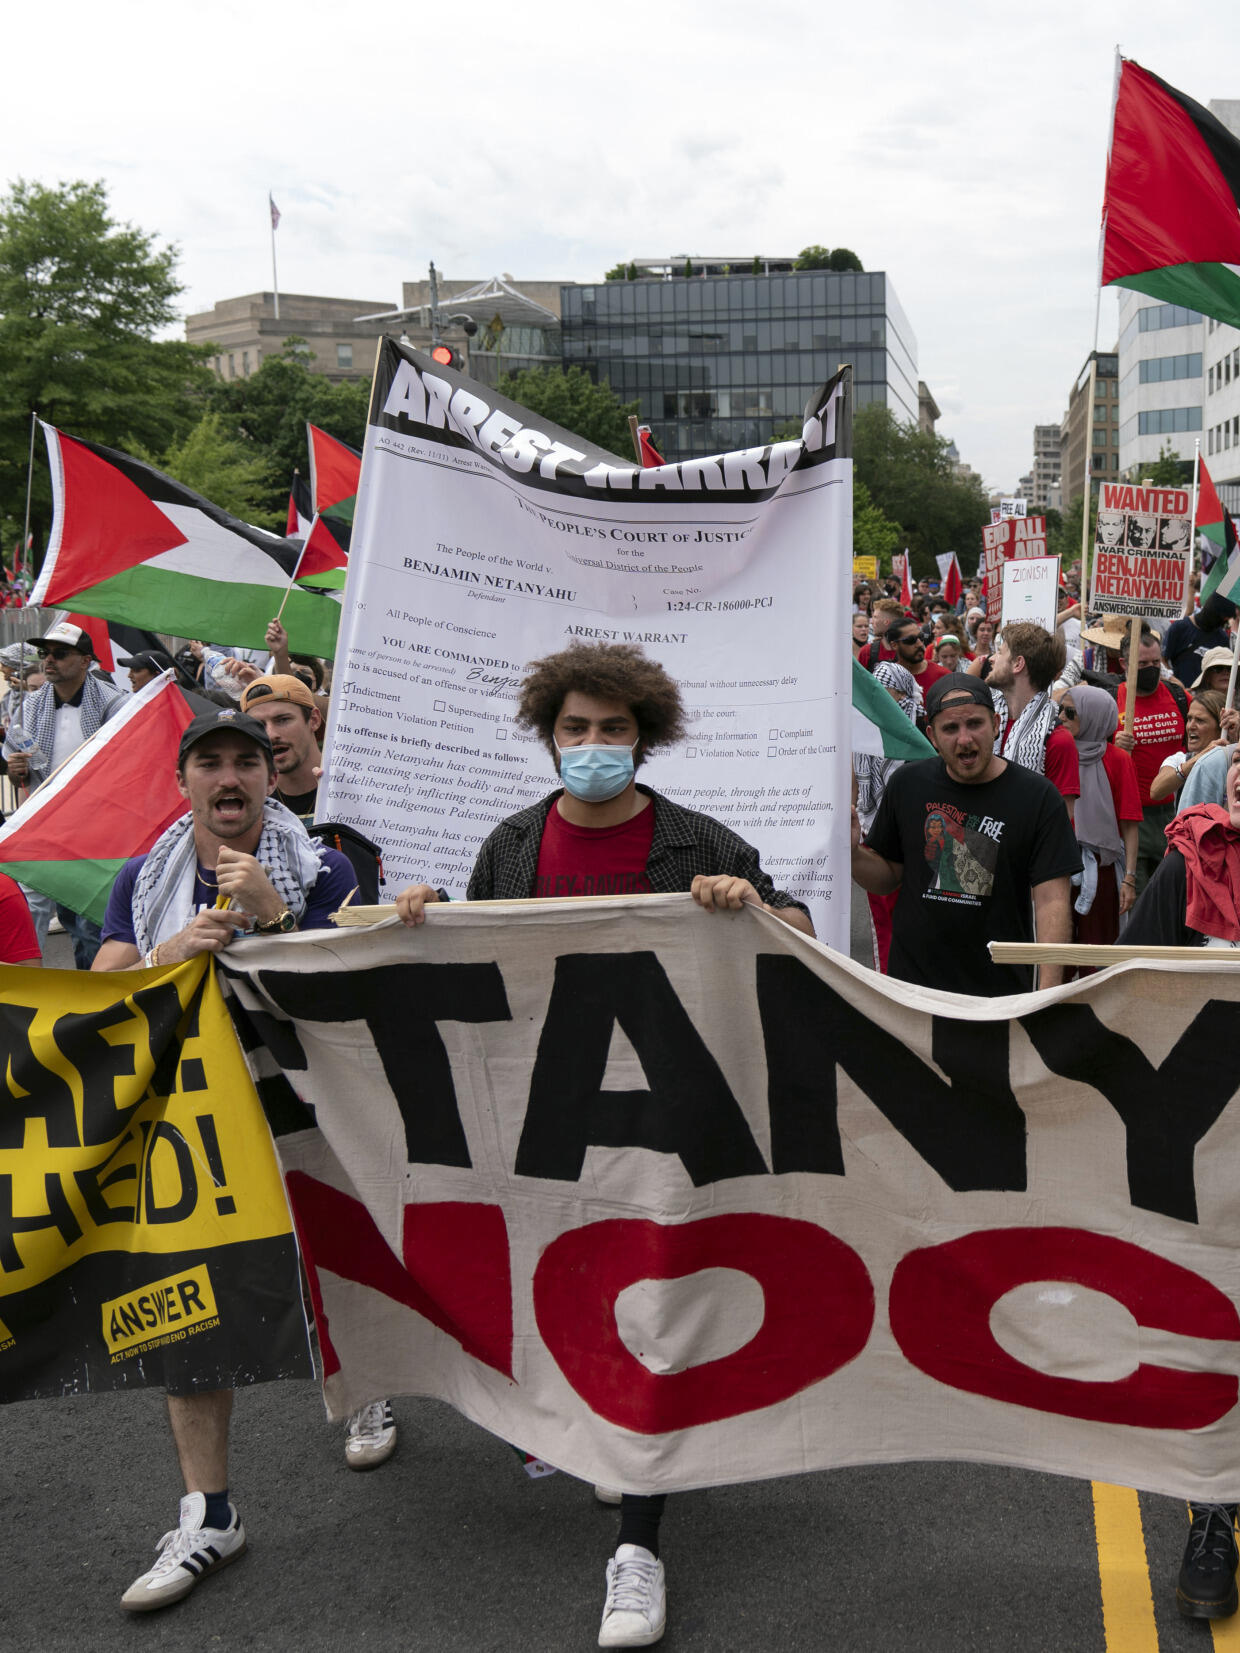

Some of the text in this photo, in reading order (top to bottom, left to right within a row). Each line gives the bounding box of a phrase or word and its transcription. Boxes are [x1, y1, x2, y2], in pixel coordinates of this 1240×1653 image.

[383, 358, 587, 480] ARREST
[452, 456, 472, 468] Arrest
[1104, 485, 1188, 515] WANTED
[1002, 503, 1013, 515] FREE
[1015, 503, 1024, 516] ALL
[610, 528, 668, 543] COURT
[672, 533, 690, 543] OF
[983, 517, 1046, 549] END ALL
[436, 543, 543, 572] The People of the World
[617, 548, 644, 557] for the
[1014, 540, 1045, 559] AID
[1098, 546, 1186, 560] WAR CRIMINAL
[606, 560, 639, 572] District
[1012, 566, 1048, 583] ZIONISM
[1097, 553, 1185, 581] BENJAMIN
[403, 557, 577, 602] BENJAMIN NETANYAHU
[1095, 574, 1184, 601] NETANYAHU
[467, 589, 506, 604] Defendant
[663, 587, 702, 595] Case No.
[666, 596, 773, 612] 1:24-CR-186000-PCJ
[1093, 601, 1182, 619] ANSWERCOALITION.ORG
[386, 608, 497, 639] All People of Conscience
[564, 624, 689, 644] ARREST WARRANT
[376, 652, 402, 664] person
[382, 635, 406, 649] YOU
[408, 642, 432, 655] ARE
[434, 647, 509, 670] COMMANDED
[372, 666, 466, 693] accused offense
[709, 680, 737, 688] without
[739, 678, 779, 689] unnecessary
[781, 676, 798, 687] delay
[352, 684, 401, 703] Indictment
[349, 702, 474, 735] Probation Violation Petition
[448, 704, 501, 723] Superseding
[702, 709, 715, 718] the
[1136, 728, 1176, 737] MEMBERS
[1155, 720, 1178, 728] GUILD
[715, 732, 758, 741] Information
[779, 729, 813, 740] Complaint
[354, 727, 528, 764] offense briefly described follows:
[699, 749, 760, 758] Violation Notice
[778, 745, 836, 757] Order Court
[383, 748, 523, 782] Netanyahu has committed
[346, 773, 466, 804] deliberately inflicting
[367, 763, 551, 800] causing serious bodily and mental
[694, 787, 800, 799] people, through the acts
[365, 790, 446, 816] the indigenous
[699, 800, 834, 814] prevent birth and repopulation,
[743, 818, 762, 827] with
[764, 817, 778, 827] the
[779, 817, 804, 827] intent
[926, 802, 967, 824] PALESTINE
[378, 819, 439, 839] Netanyahu
[441, 828, 461, 842] has
[978, 816, 1005, 843] FREE
[370, 833, 473, 859] intentional attacks
[765, 855, 815, 867] destruction
[431, 876, 454, 887] and
[792, 871, 833, 882] civilians
[110, 1280, 206, 1342] ANSWER
[111, 1353, 124, 1365] ACT
[125, 1347, 139, 1359] NOW
[171, 1331, 186, 1343] END
[188, 1318, 220, 1337] RACISM
